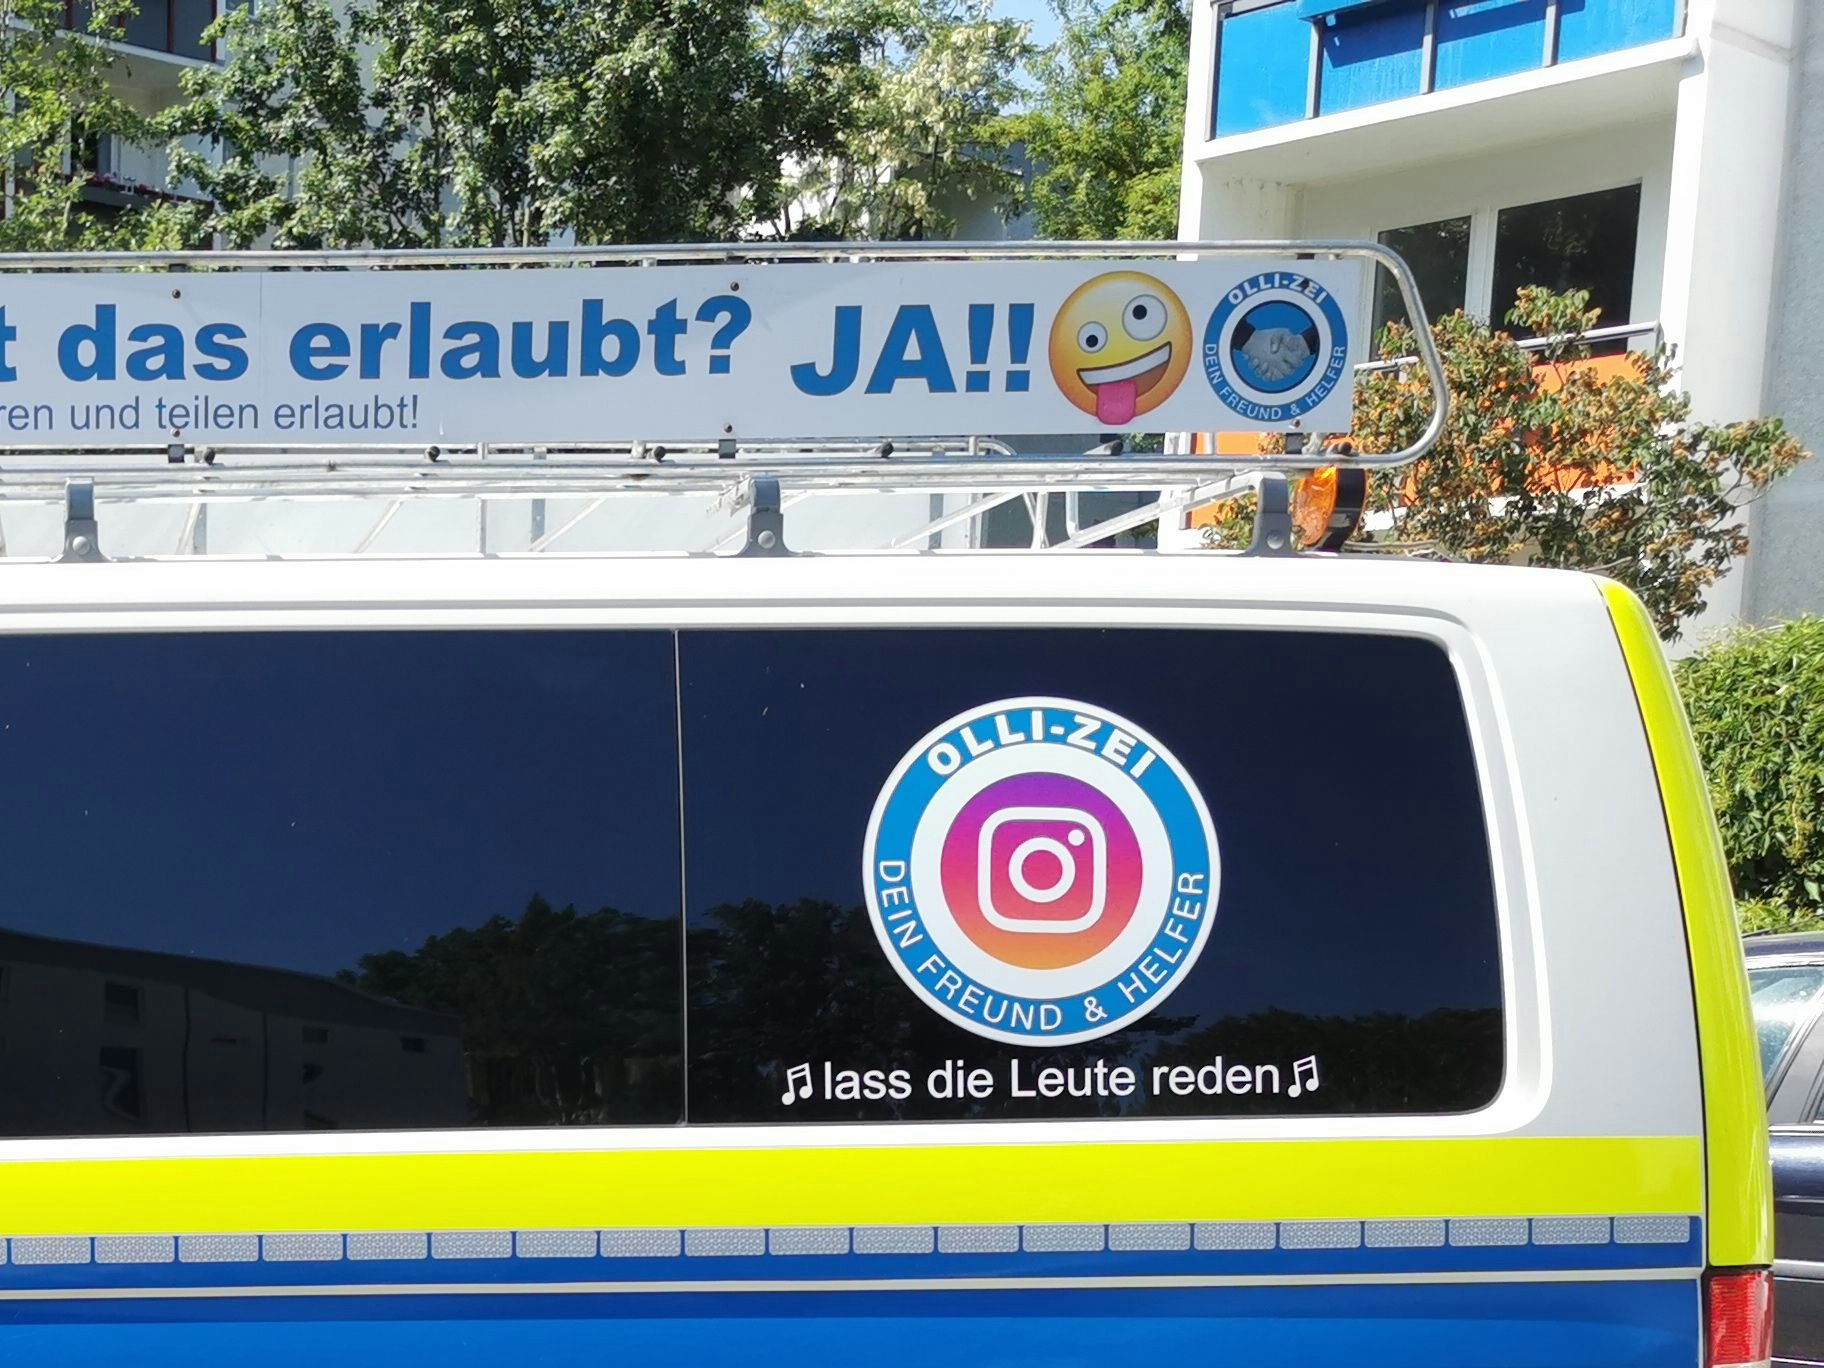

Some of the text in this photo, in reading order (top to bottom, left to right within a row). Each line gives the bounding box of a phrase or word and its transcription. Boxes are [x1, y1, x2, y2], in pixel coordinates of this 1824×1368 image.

[1228, 273, 1328, 304] OLLI-ZEI
[58, 304, 248, 381] das
[289, 289, 752, 380] erlaubt?
[791, 303, 1034, 396] JA!!
[71, 396, 139, 430] und
[156, 396, 258, 430] teilen
[275, 395, 418, 430] erlaubt!
[1205, 344, 1345, 420] DEIN FREUND & HELFER
[927, 710, 1156, 777] OLLI-ZEI
[879, 860, 1204, 1031] DEIN FREUND & HELFER
[824, 1056, 1280, 1100] lass die Leute reden
